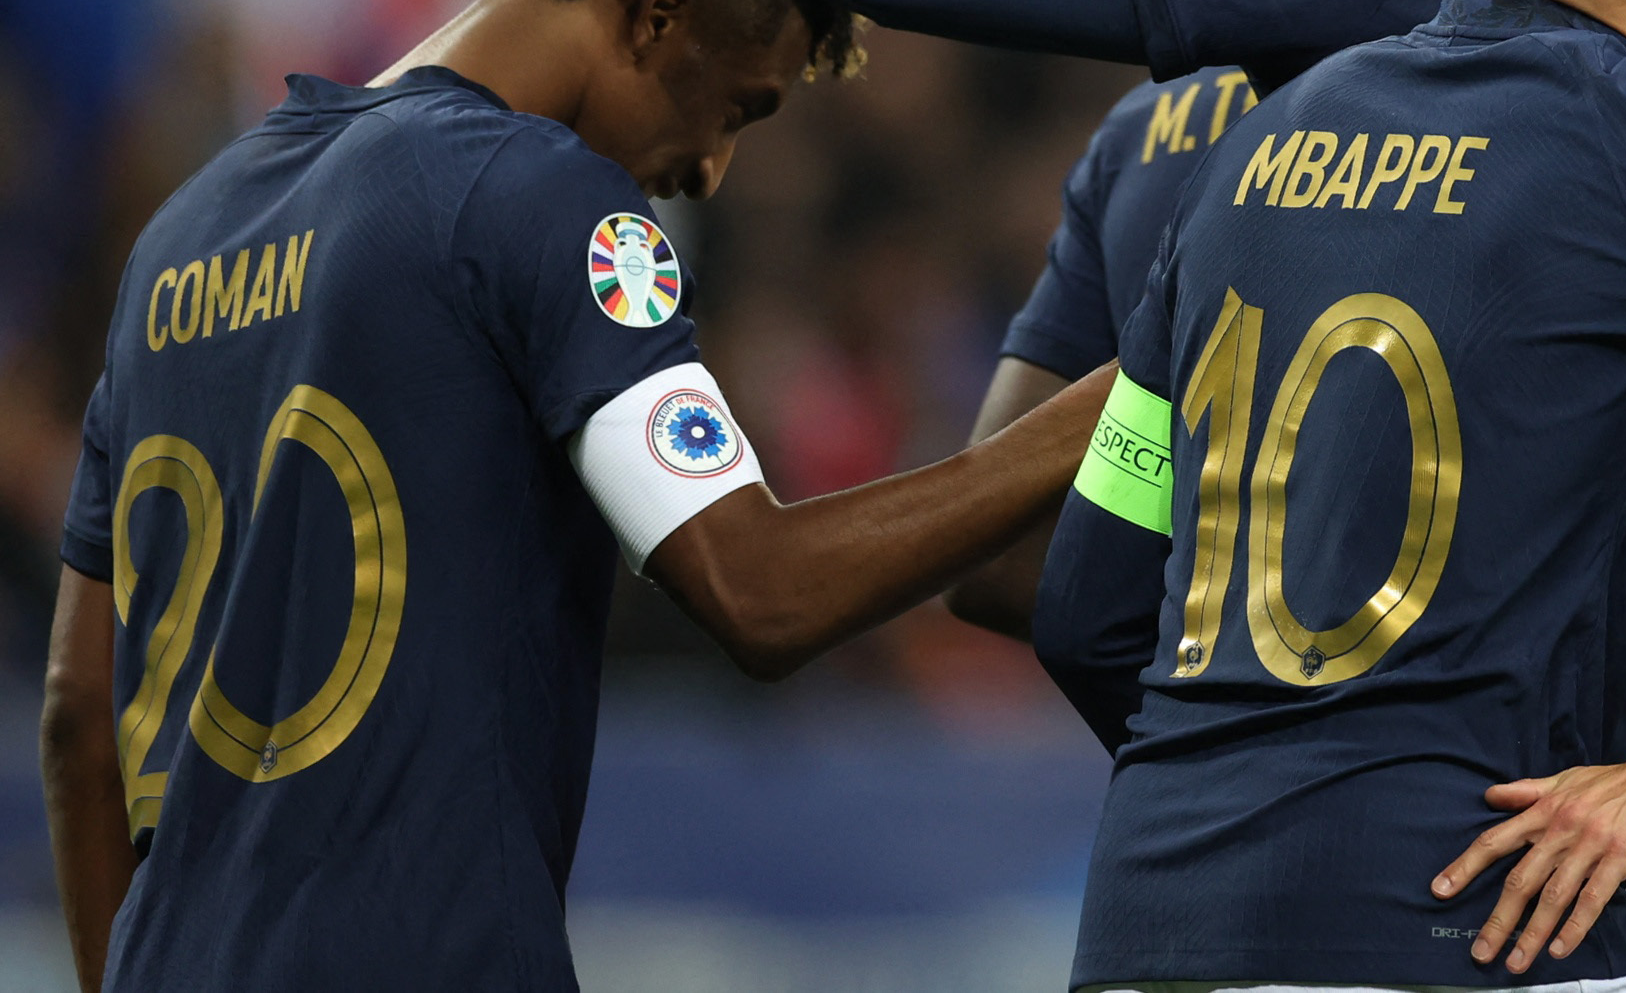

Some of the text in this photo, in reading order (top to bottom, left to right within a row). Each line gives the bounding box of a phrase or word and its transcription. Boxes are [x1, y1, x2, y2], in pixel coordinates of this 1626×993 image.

[1141, 71, 1260, 165] M.T
[1233, 129, 1491, 215] MBAPPE
[146, 228, 315, 353] COMAN
[655, 395, 716, 438] LE BLEUET DE FRANCE
[1094, 419, 1172, 478] ESPECT
[1168, 285, 1464, 687] 10
[113, 384, 407, 844] 20
